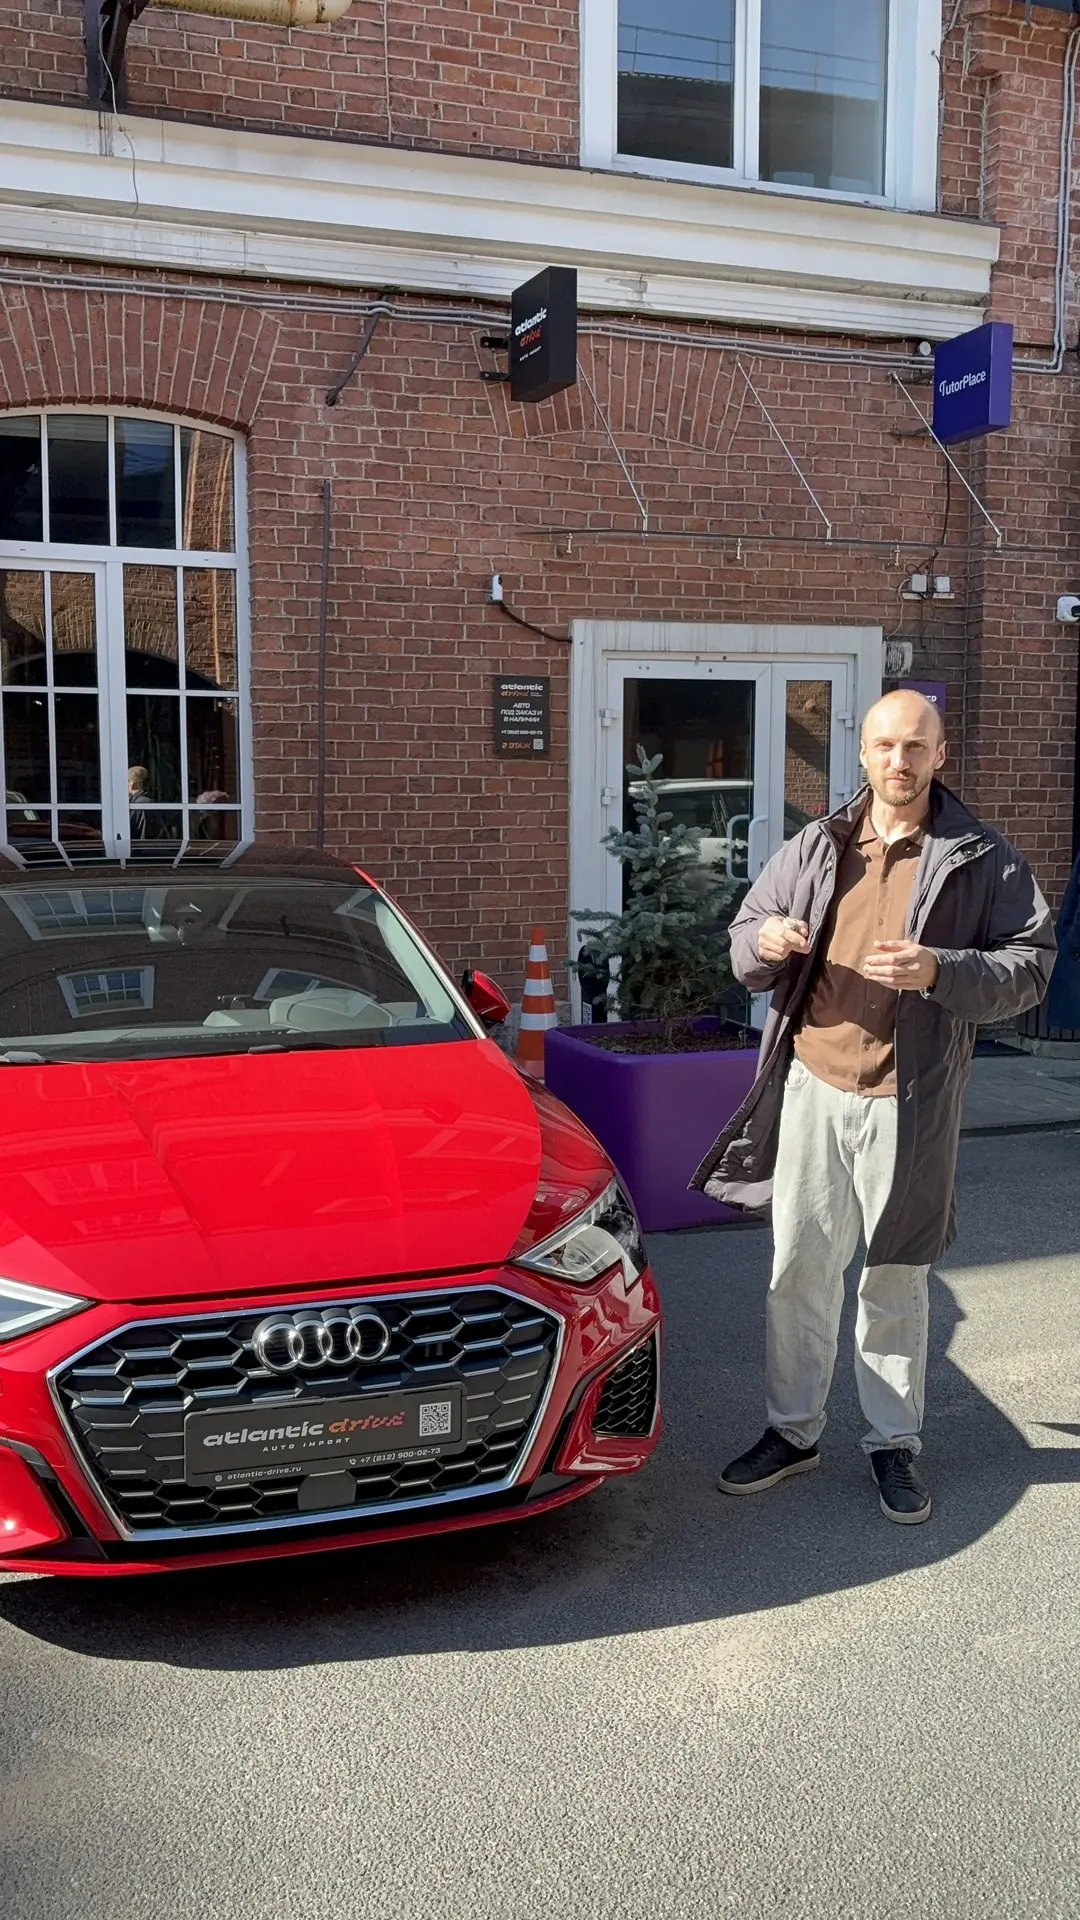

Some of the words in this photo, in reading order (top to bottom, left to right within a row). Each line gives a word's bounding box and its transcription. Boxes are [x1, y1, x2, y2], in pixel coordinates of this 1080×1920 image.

[515, 307, 547, 336] atlantic
[939, 371, 986, 397] TutorPlace
[203, 1421, 324, 1447] atlantic
[328, 1411, 405, 1433] drive
[262, 1443, 295, 1452] AUTO
[303, 1437, 350, 1448] IMPORT
[372, 1453, 395, 1463] (812)
[397, 1447, 441, 1459] 900-02-73
[227, 1466, 302, 1480] atlantic-drive.ru
